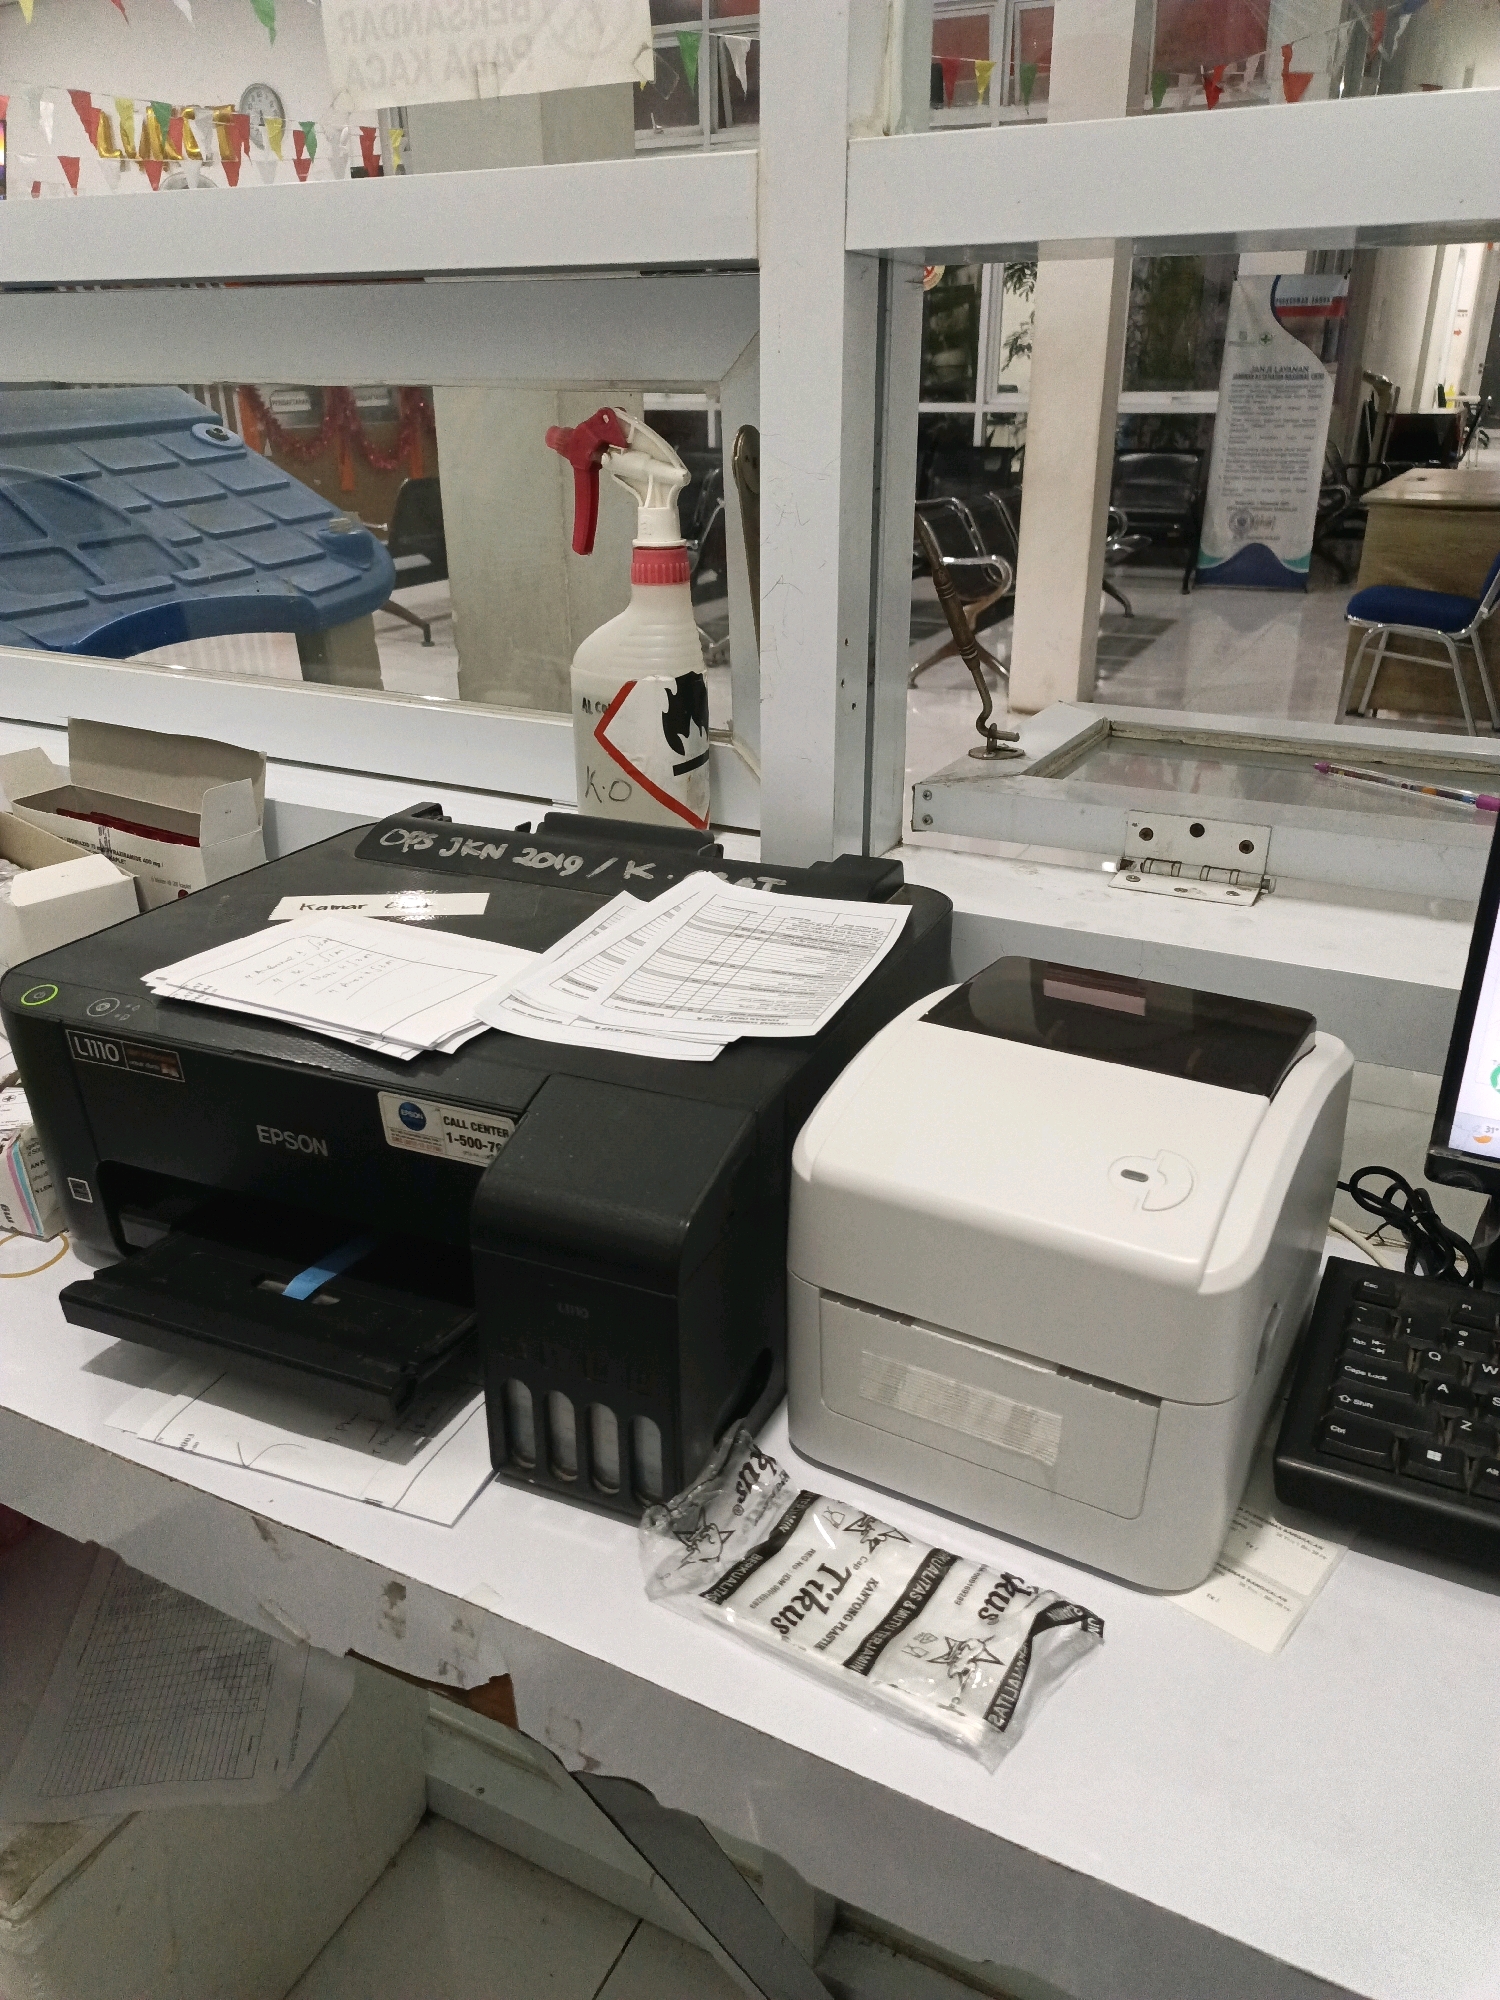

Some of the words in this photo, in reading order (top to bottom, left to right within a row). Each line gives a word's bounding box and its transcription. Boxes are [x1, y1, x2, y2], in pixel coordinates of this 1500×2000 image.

[379, 828, 437, 852] OPS
[438, 836, 508, 862] JKN
[511, 847, 584, 877] 2019
[299, 902, 368, 911] Kamar
[73, 1036, 120, 1062] L1110
[442, 1116, 469, 1130] CALL
[470, 1122, 510, 1139] CENTER
[255, 1124, 329, 1158] EPSON
[1363, 1281, 1379, 1290] Esc
[1351, 1337, 1367, 1346] Tab
[1428, 1351, 1442, 1362] Q
[1344, 1365, 1367, 1376] Caps
[1367, 1372, 1388, 1382] Lock
[1481, 1363, 1499, 1375] W
[1437, 1383, 1449, 1394] A
[1352, 1398, 1374, 1409] Shift
[1329, 1424, 1347, 1436] Ctrl
[1460, 1419, 1473, 1432] Z
[769, 1562, 853, 1635] Tikus
[842, 1577, 880, 1622] KANTONG
